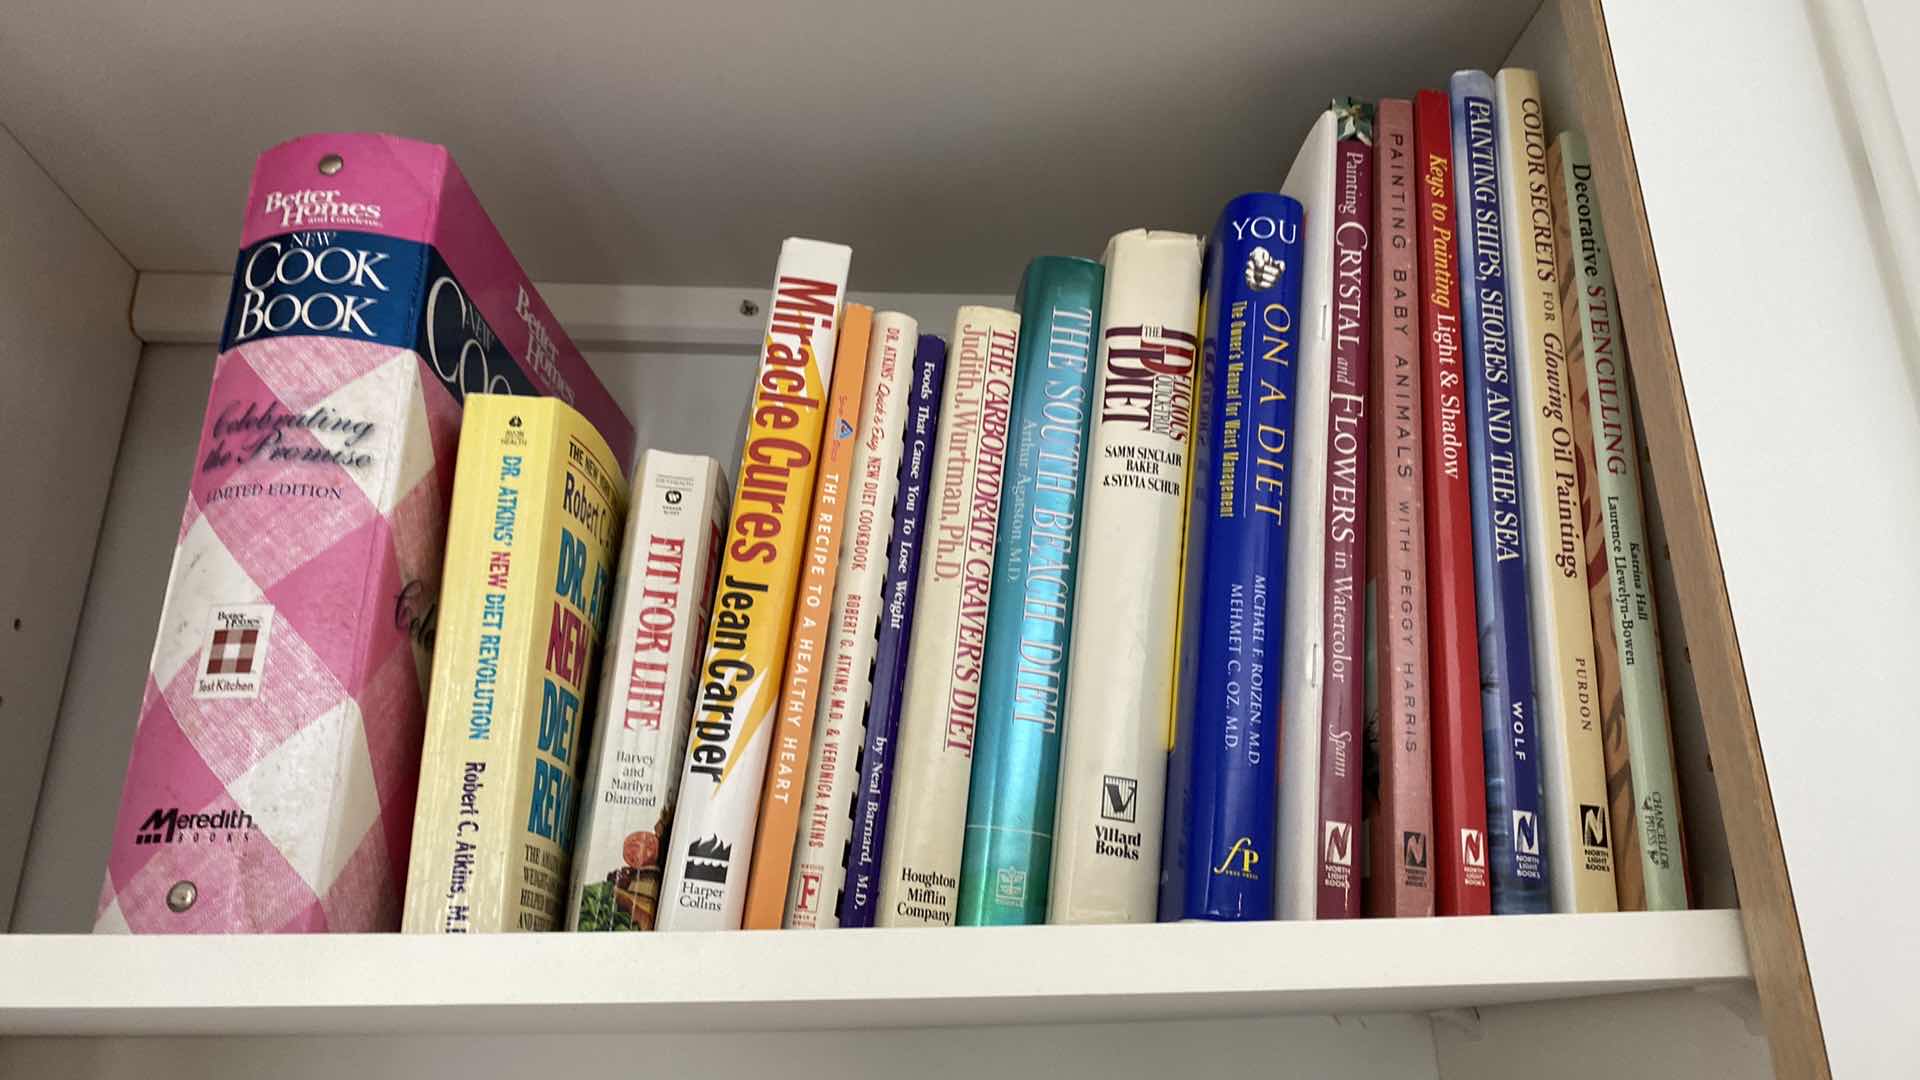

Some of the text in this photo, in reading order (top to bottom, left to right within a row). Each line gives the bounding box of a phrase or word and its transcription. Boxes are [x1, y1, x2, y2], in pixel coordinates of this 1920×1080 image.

[265, 189, 341, 214] Better
[281, 202, 383, 228] Homes
[290, 231, 336, 248] NEW
[1232, 216, 1297, 245] YOU
[245, 242, 390, 292] COOK
[236, 288, 379, 341] BOOK
[1231, 300, 1248, 319] The
[1424, 152, 1463, 480] Keys to Painting Light & Shadow
[1572, 163, 1628, 476] Decorative STENCILLING
[1228, 320, 1247, 360] Owner's
[1469, 100, 1521, 564] PAINTING SHIPS, SHORES AND THE SEA
[1521, 97, 1581, 579] COLOR SECRETS FOR Glowing Oil Paintings
[1226, 362, 1245, 399] Manual
[213, 400, 374, 447] Celebrating
[730, 276, 838, 565] Miracle Cures
[1223, 418, 1241, 449] Waist
[1254, 303, 1291, 527] ON A DIET
[1330, 151, 1369, 684] Painting CRYSTAL and FLOWERS in Watercolor
[933, 323, 988, 582] Judith J. Ph.D.
[1104, 445, 1182, 468] SAMM SINCLAIR
[1390, 133, 1417, 753] PAINTING BABY ANIMALS WITH PEGGY HARRIS
[867, 456, 882, 481] NEW
[1103, 475, 1181, 497] & SYLVIA SCHUR
[1126, 458, 1160, 476] BAKER
[1219, 450, 1240, 517] Management
[206, 483, 343, 504] LIMITED EDITION
[822, 473, 839, 505] THE
[861, 482, 879, 507] DIET
[888, 361, 936, 630] Foods That Cause You To Lose Weight
[1007, 419, 1038, 583] Arthur M.D.
[851, 509, 874, 571] COOKBOOK
[1011, 304, 1092, 735] THE SOUTH BEACH DIET
[645, 534, 686, 586] FIT
[811, 512, 833, 576] RECIPE
[947, 329, 1017, 759] THE CARBOHYDRATE CRAVER'S DIET
[555, 526, 588, 615] DR.
[1607, 495, 1636, 667] Laurence Llewelyn-Bowen
[1629, 541, 1649, 621] Katrina Hall
[468, 455, 522, 740] DR. ATKINS' NEW DIET REVOLUTION
[806, 583, 824, 608] TO
[842, 594, 862, 636] ROBERT
[1252, 574, 1266, 642] MICHAEL
[635, 587, 679, 654] FOR
[802, 615, 817, 630] A
[545, 600, 591, 691] NEW
[1224, 583, 1243, 751] MEHMET C. M.D.
[1252, 647, 1264, 658] F.
[216, 678, 255, 692] Kitchen
[624, 660, 669, 731] LIFE
[691, 575, 769, 784] Jean Carper
[787, 638, 813, 727] HEALTHY
[1575, 657, 1593, 732] PURDON
[1247, 730, 1261, 768] M.D.
[1328, 724, 1352, 778] Spann
[1511, 701, 1526, 761] WOLF
[616, 750, 656, 766] Harvey
[622, 766, 645, 779] and
[774, 735, 799, 805] HEART
[815, 742, 840, 800] VERONICA
[604, 791, 657, 808] Diamond
[611, 777, 654, 793] Marilyn
[139, 808, 253, 844] Meredith
[446, 761, 486, 898] Robert C. Atkins,
[808, 804, 829, 848] ATKINS
[853, 736, 888, 910] by Neal Barnard, M.D.
[1095, 824, 1142, 847] Villard
[1096, 839, 1140, 861] Books
[1325, 864, 1351, 876] NORTH
[1515, 854, 1540, 865] NORTH
[1584, 848, 1610, 858] NORTH
[1585, 863, 1611, 873] BOOKS
[1587, 856, 1608, 866] LIGHT
[682, 881, 725, 899] Harper
[902, 867, 957, 889] Houghton
[1516, 869, 1541, 879] BOOKS
[680, 896, 723, 913] Collins
[897, 902, 952, 926] Company
[907, 887, 947, 907] Mifflin
